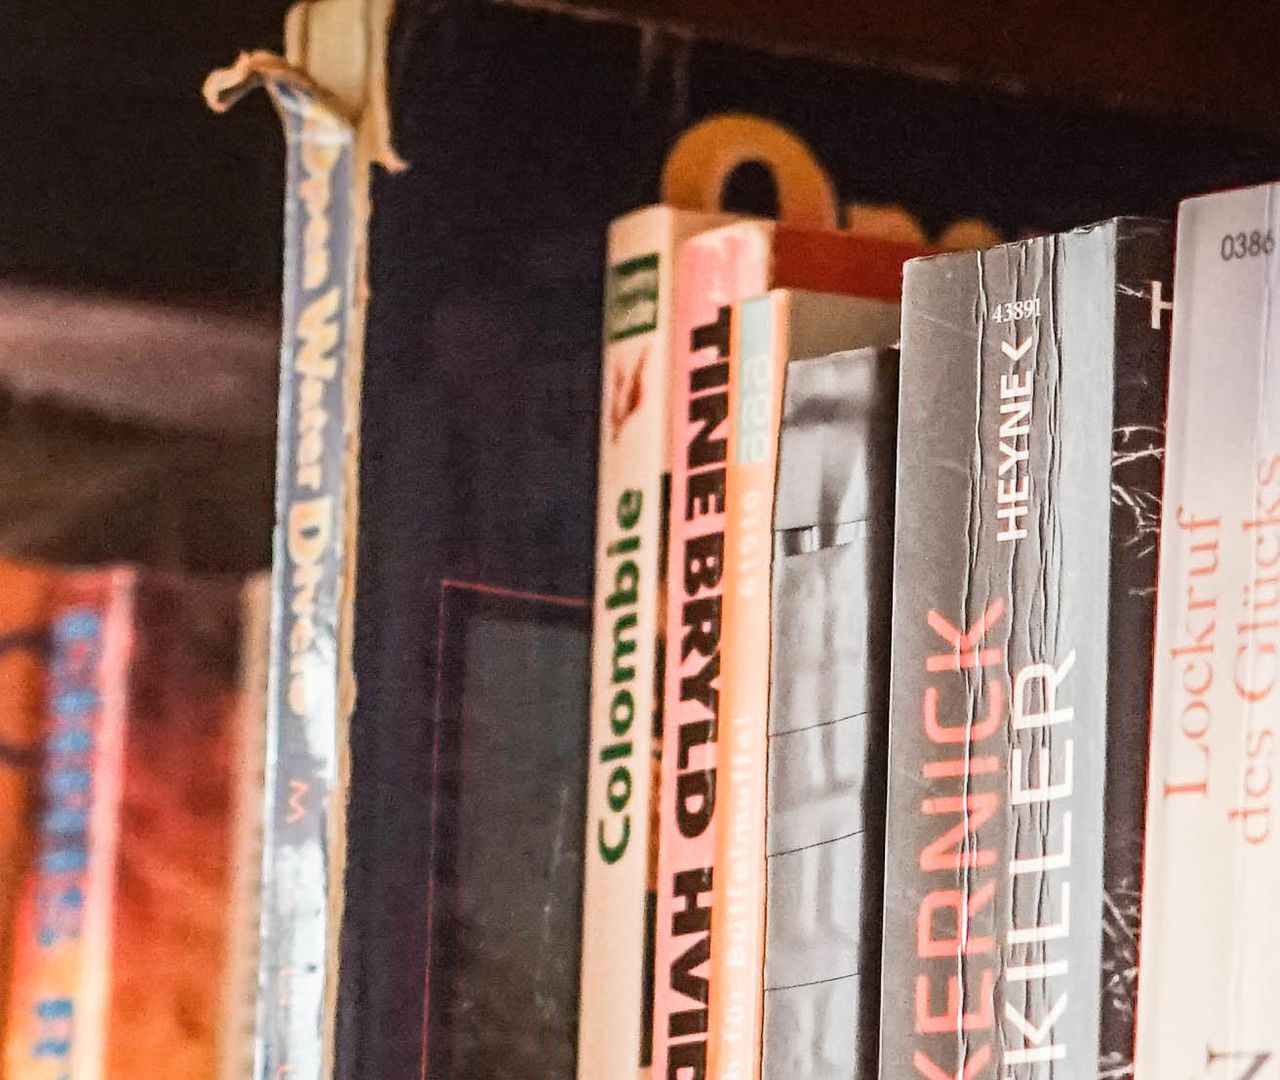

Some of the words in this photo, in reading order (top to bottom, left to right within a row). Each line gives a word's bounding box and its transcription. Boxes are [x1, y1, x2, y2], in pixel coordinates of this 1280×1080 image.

[992, 299, 1042, 323] 43891
[1220, 230, 1276, 261] 0386
[292, 292, 343, 491] Water
[684, 306, 732, 521] TINE
[995, 368, 1034, 543] HEYNE
[597, 488, 642, 865] Colombie
[671, 532, 726, 838] BRYLD
[1162, 506, 1222, 800] Lockruf
[1228, 730, 1273, 844] des
